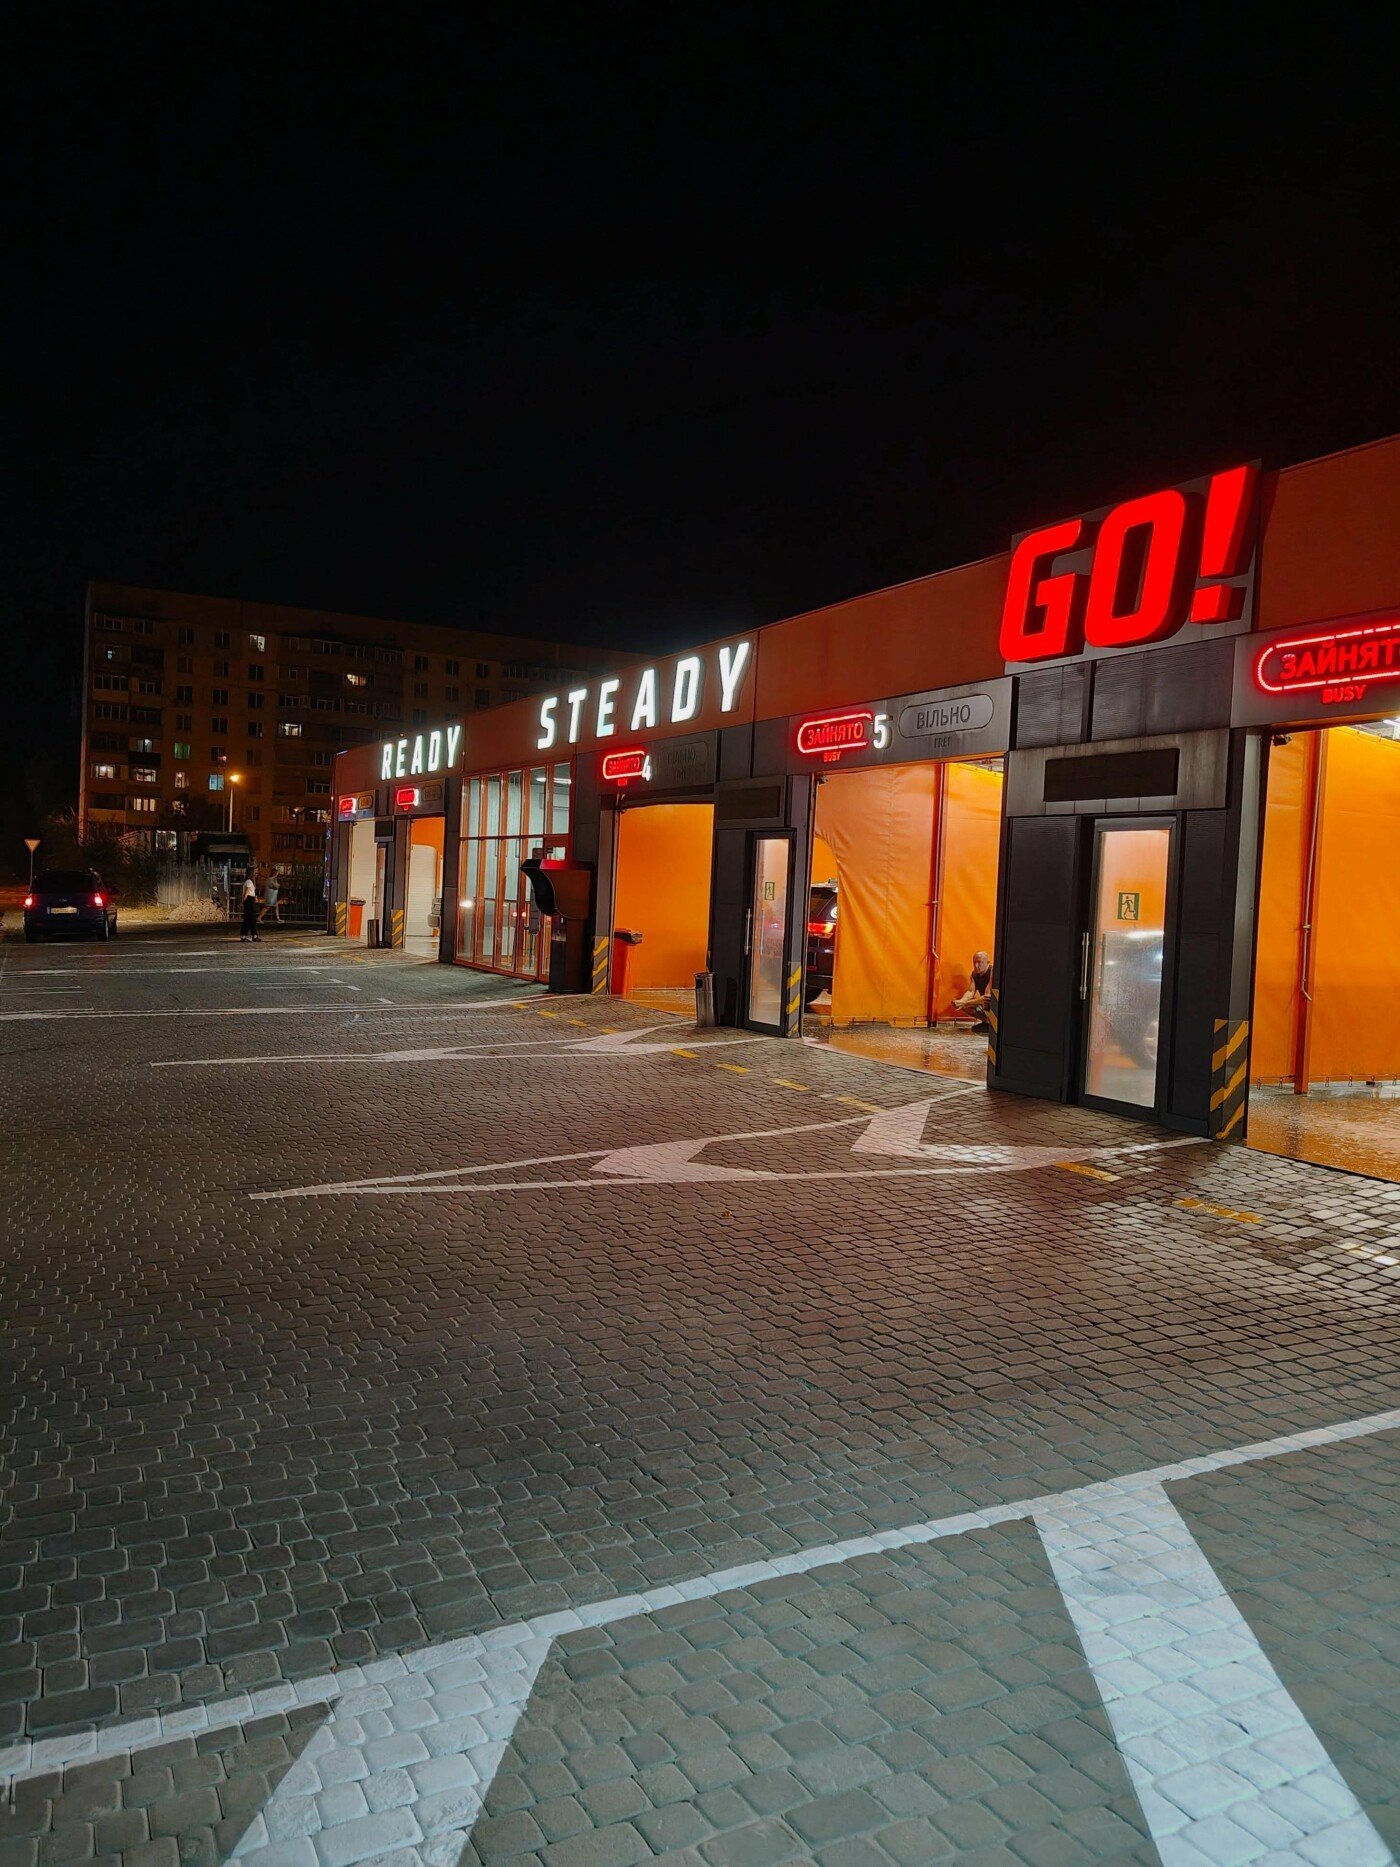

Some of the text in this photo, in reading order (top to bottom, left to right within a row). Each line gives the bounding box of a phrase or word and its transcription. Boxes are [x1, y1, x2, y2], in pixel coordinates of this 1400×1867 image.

[999, 466, 1248, 662] GO!
[1279, 637, 1400, 680] ЗАЙНЯТ
[537, 642, 750, 750] STEADY
[1322, 684, 1367, 704] BUSY
[807, 721, 864, 746] ЗАЙНЯТО
[873, 714, 892, 749] 5
[916, 704, 971, 730] ВІЛЬНО
[381, 725, 461, 780] READY
[641, 755, 651, 781] 4
